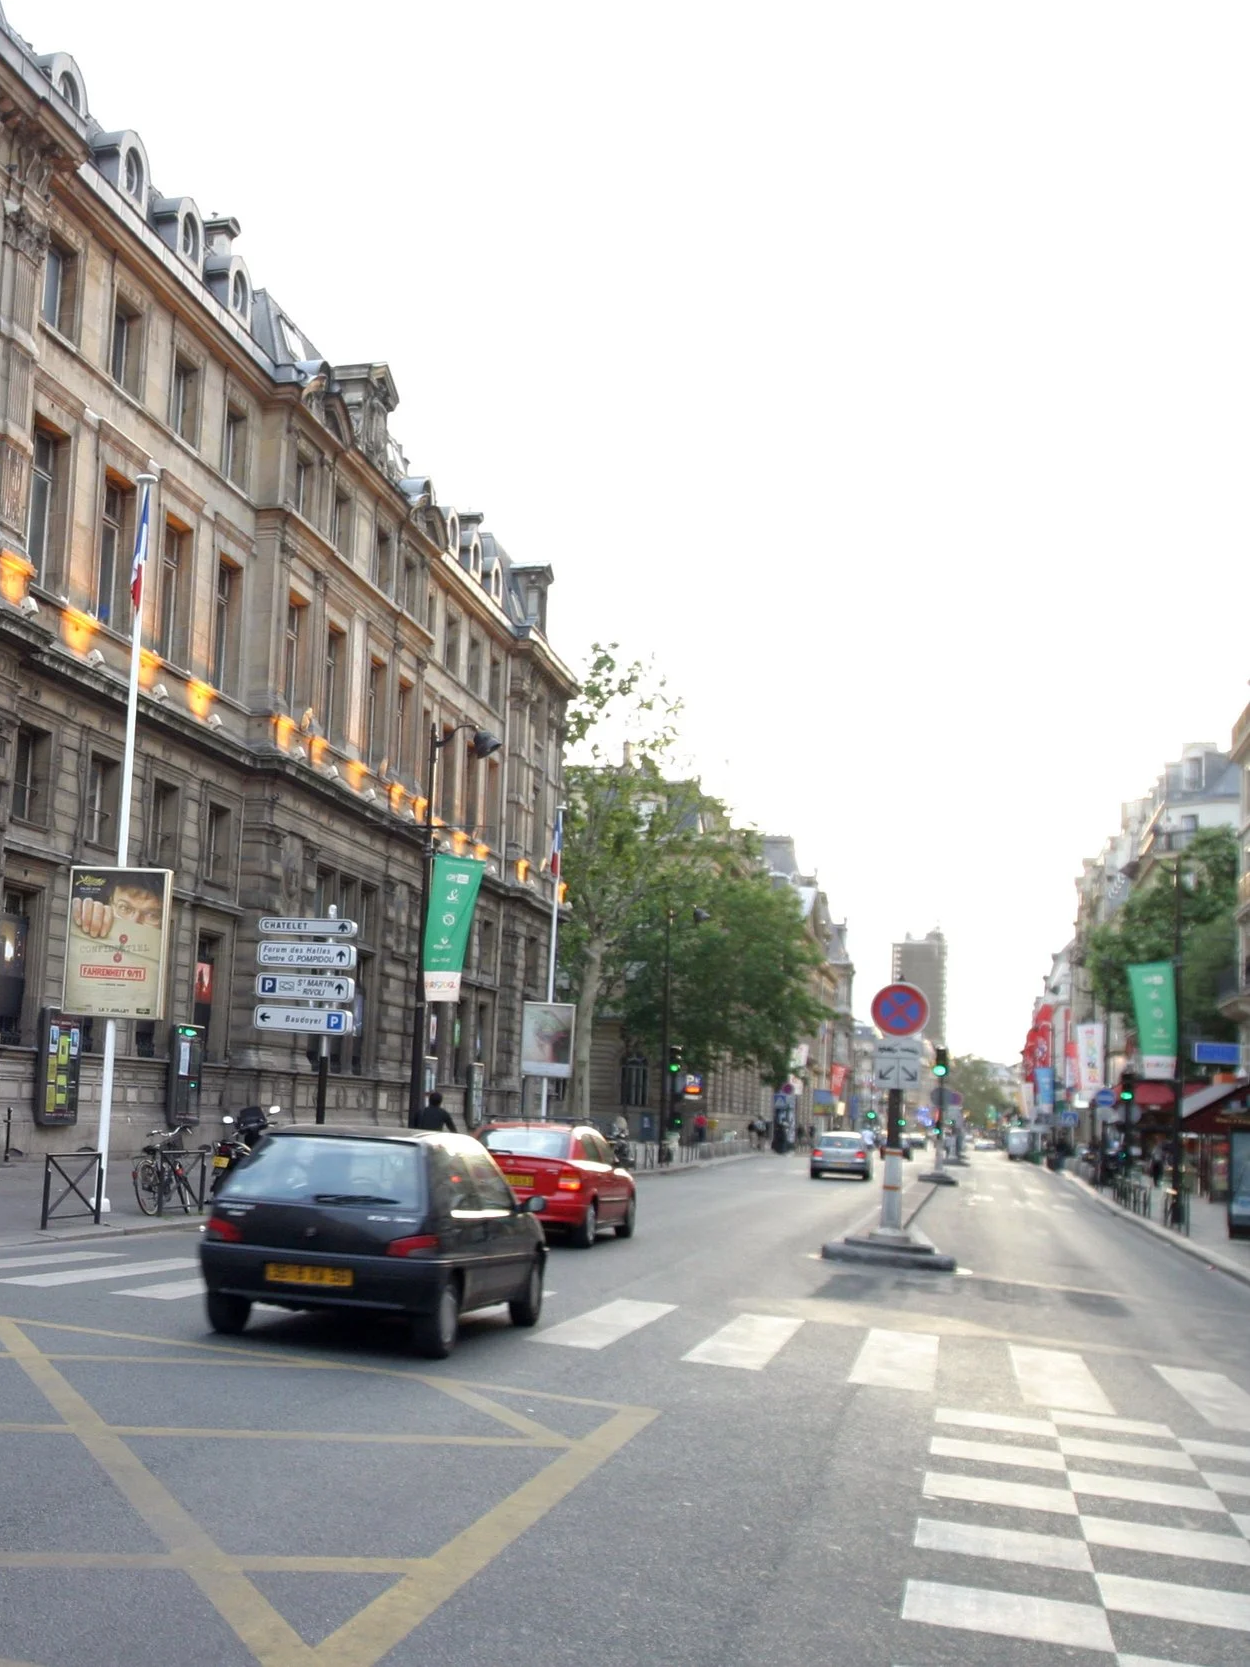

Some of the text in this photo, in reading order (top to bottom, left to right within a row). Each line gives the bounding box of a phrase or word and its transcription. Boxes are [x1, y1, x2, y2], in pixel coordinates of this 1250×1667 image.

[263, 921, 309, 930] CHATELET
[262, 944, 331, 956] Forum des Halles
[262, 953, 286, 962] Centre
[295, 955, 335, 965] POMPIDOU
[82, 967, 143, 979] FAHRENHEIT 9/11
[308, 980, 335, 989] MARTIN
